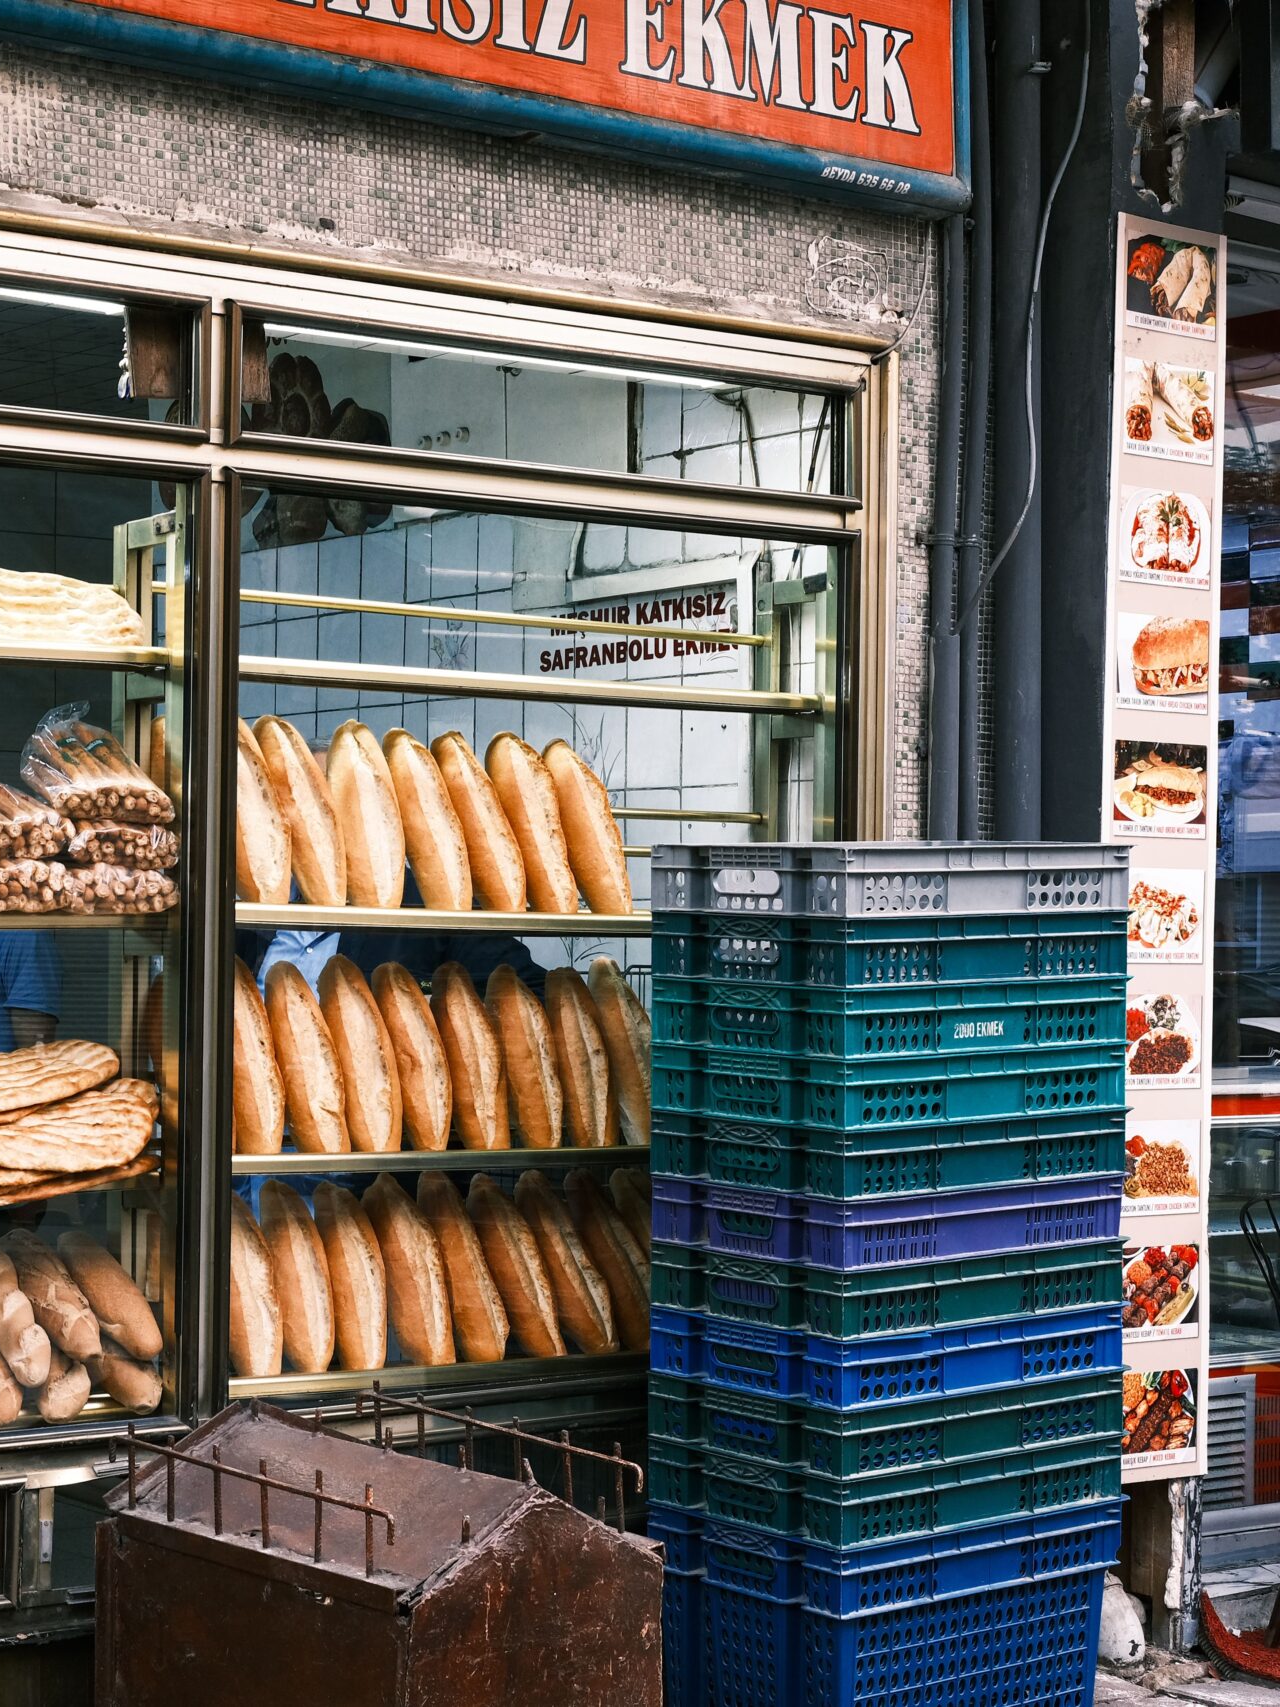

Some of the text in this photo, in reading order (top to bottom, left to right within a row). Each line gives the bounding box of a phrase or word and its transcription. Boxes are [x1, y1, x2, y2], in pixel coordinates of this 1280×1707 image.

[619, 0, 921, 136] EKMEK
[821, 166, 856, 184] BEYDA
[857, 173, 880, 188] 635
[879, 178, 896, 191] 66
[636, 592, 726, 625] KATKISIZ
[540, 638, 667, 673] SAFRANBOLU
[953, 1020, 1004, 1039] 2000 EKMEK
